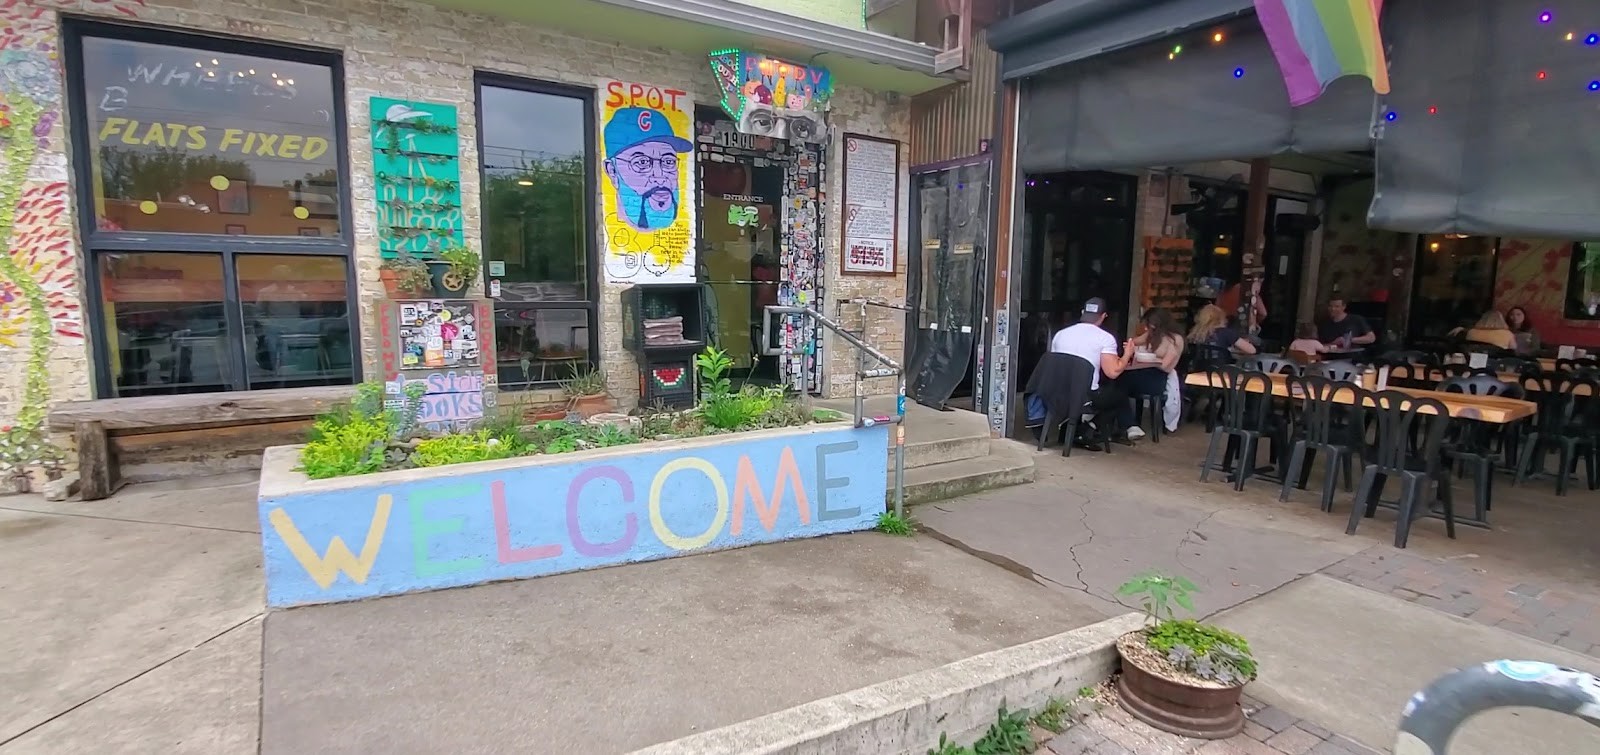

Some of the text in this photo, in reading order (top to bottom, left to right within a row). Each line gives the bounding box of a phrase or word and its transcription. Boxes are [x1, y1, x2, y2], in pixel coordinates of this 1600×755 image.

[99, 117, 328, 161] FLATS FIXED
[723, 193, 764, 203] ENTRANCE
[268, 440, 862, 590] WELCOME
